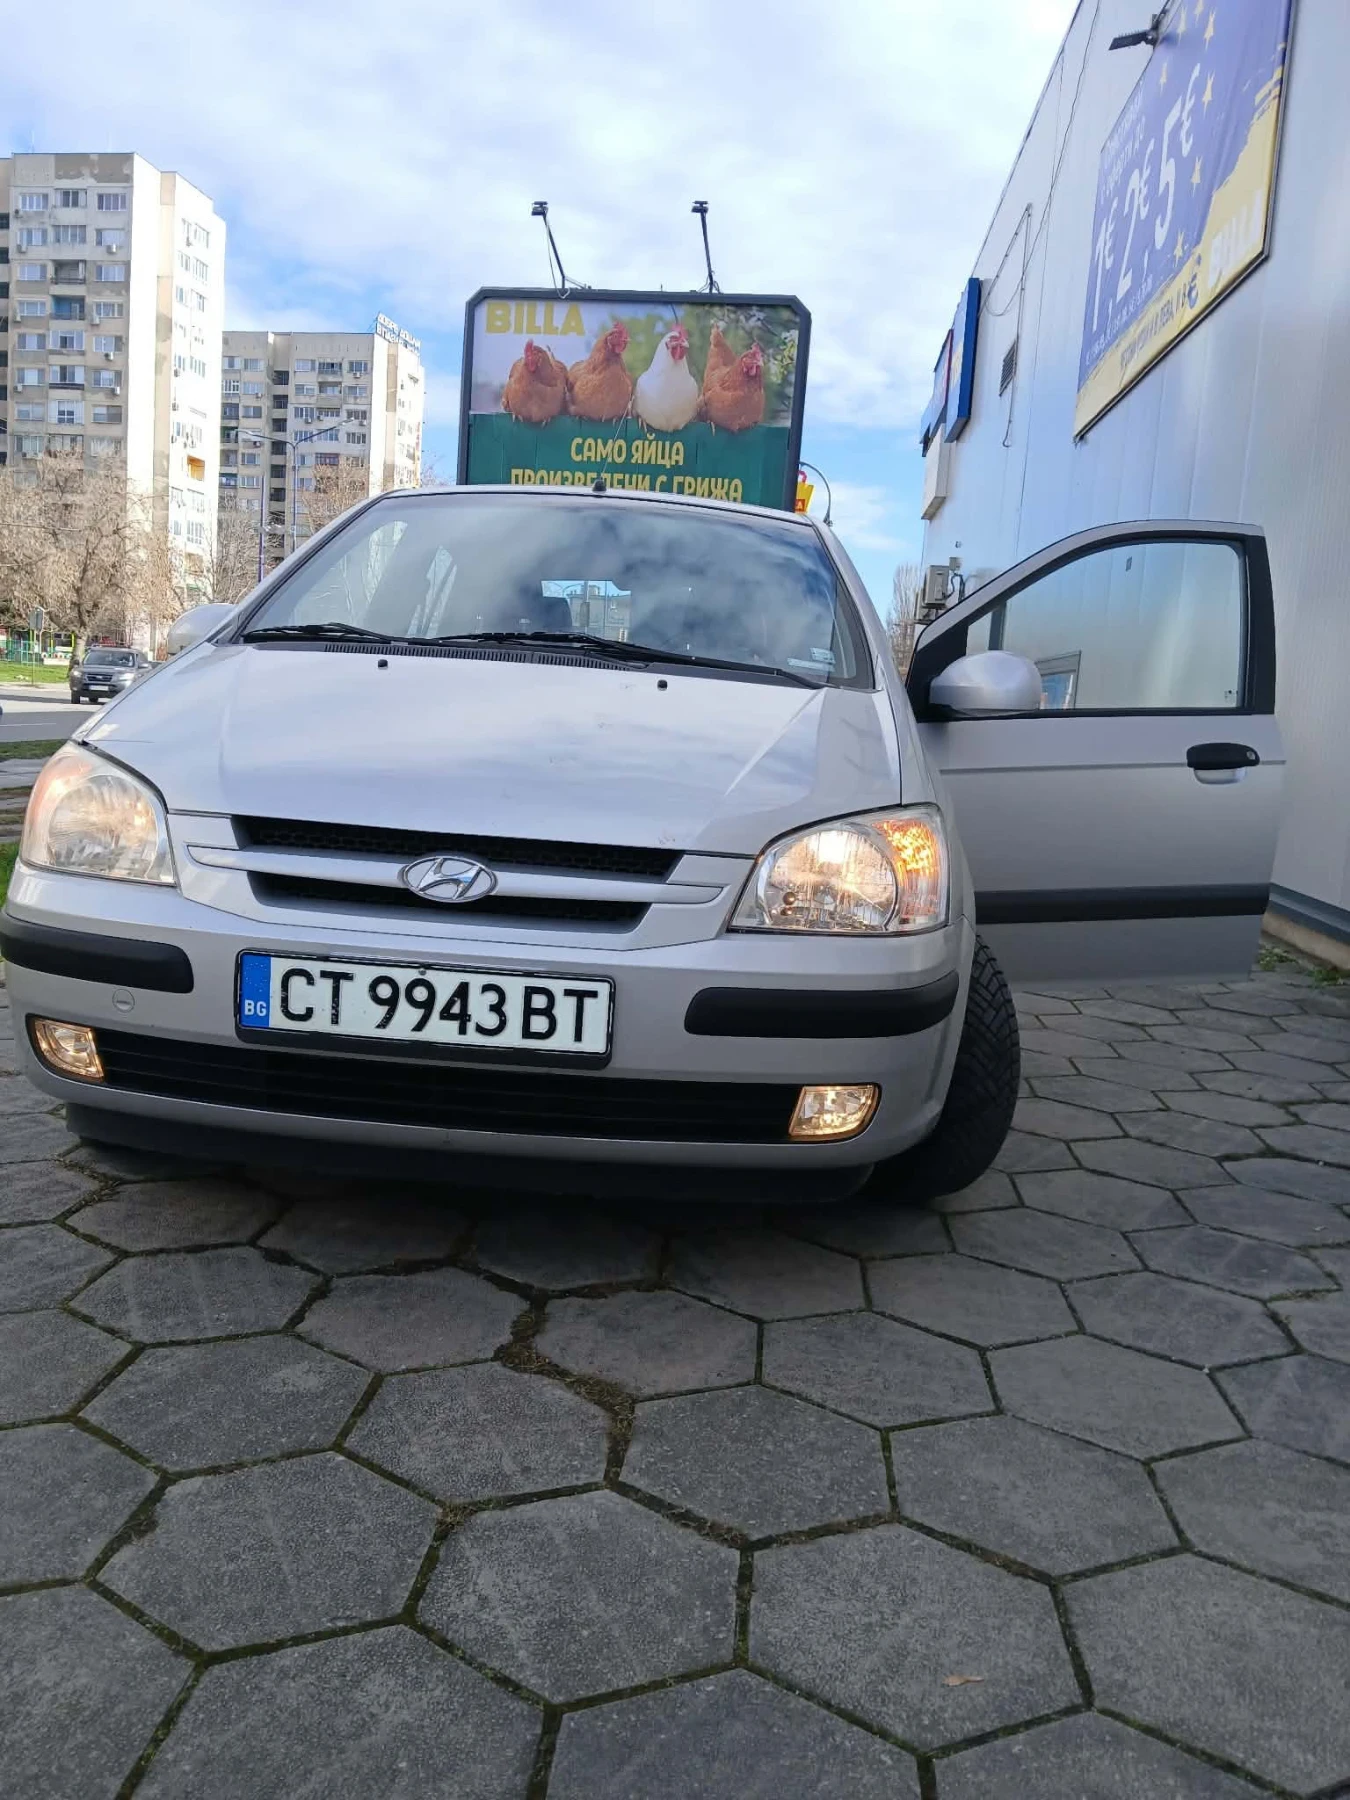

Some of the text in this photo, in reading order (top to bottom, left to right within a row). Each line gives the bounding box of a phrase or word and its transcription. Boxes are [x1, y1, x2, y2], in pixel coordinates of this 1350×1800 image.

[486, 300, 585, 336] BILLA
[570, 432, 684, 468] САМО ЯЙЦА
[655, 475, 667, 493] С
[673, 475, 742, 503] ГРИЖА
[244, 1000, 267, 1017] BG
[281, 968, 598, 1042] CT 9943 BT
